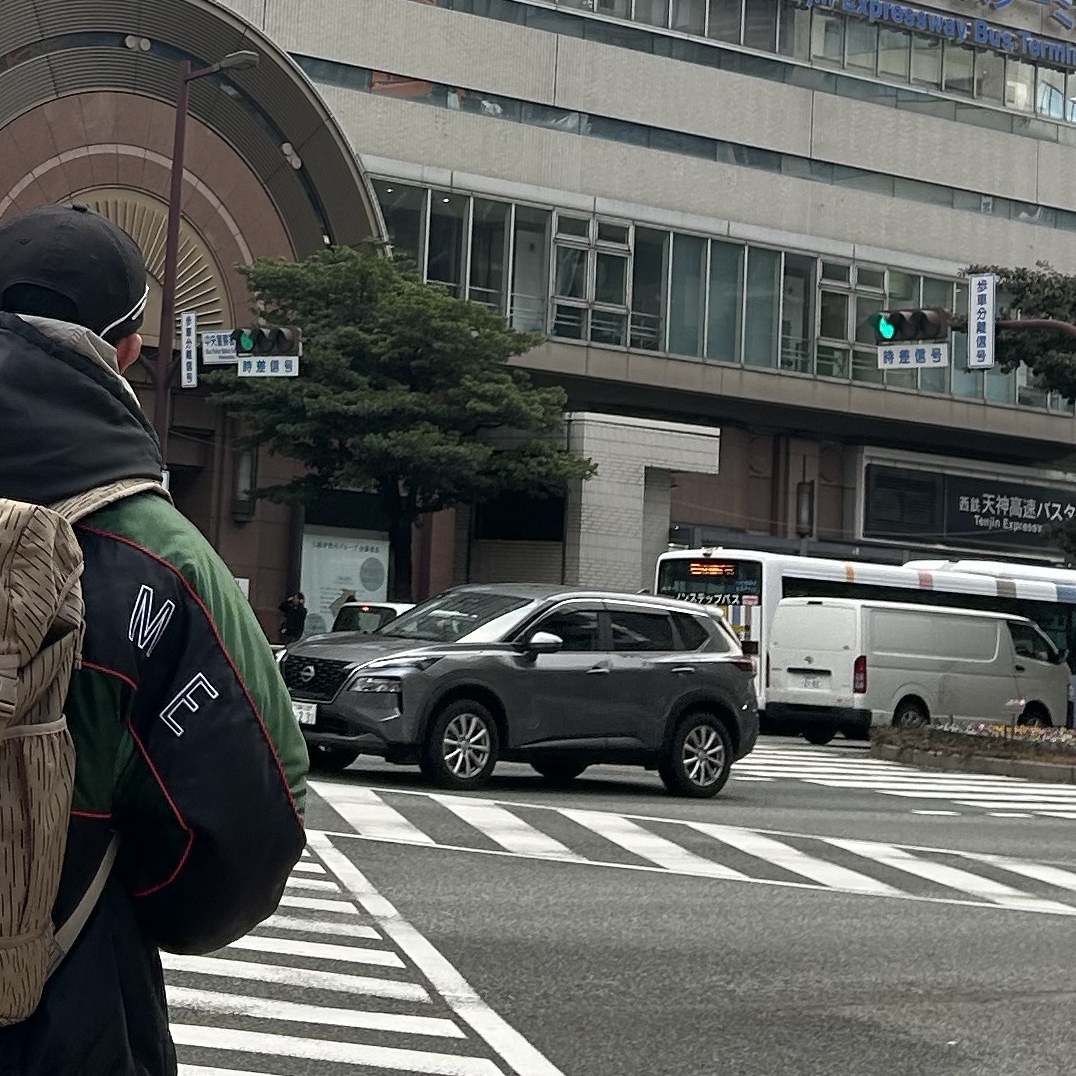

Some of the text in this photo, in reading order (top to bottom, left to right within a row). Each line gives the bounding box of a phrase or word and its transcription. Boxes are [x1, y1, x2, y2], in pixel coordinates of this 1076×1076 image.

[975, 20, 1015, 51] Bus
[975, 279, 988, 363] 歩車分離信号
[242, 359, 293, 373] 時差信号
[883, 347, 943, 365] 時差信号
